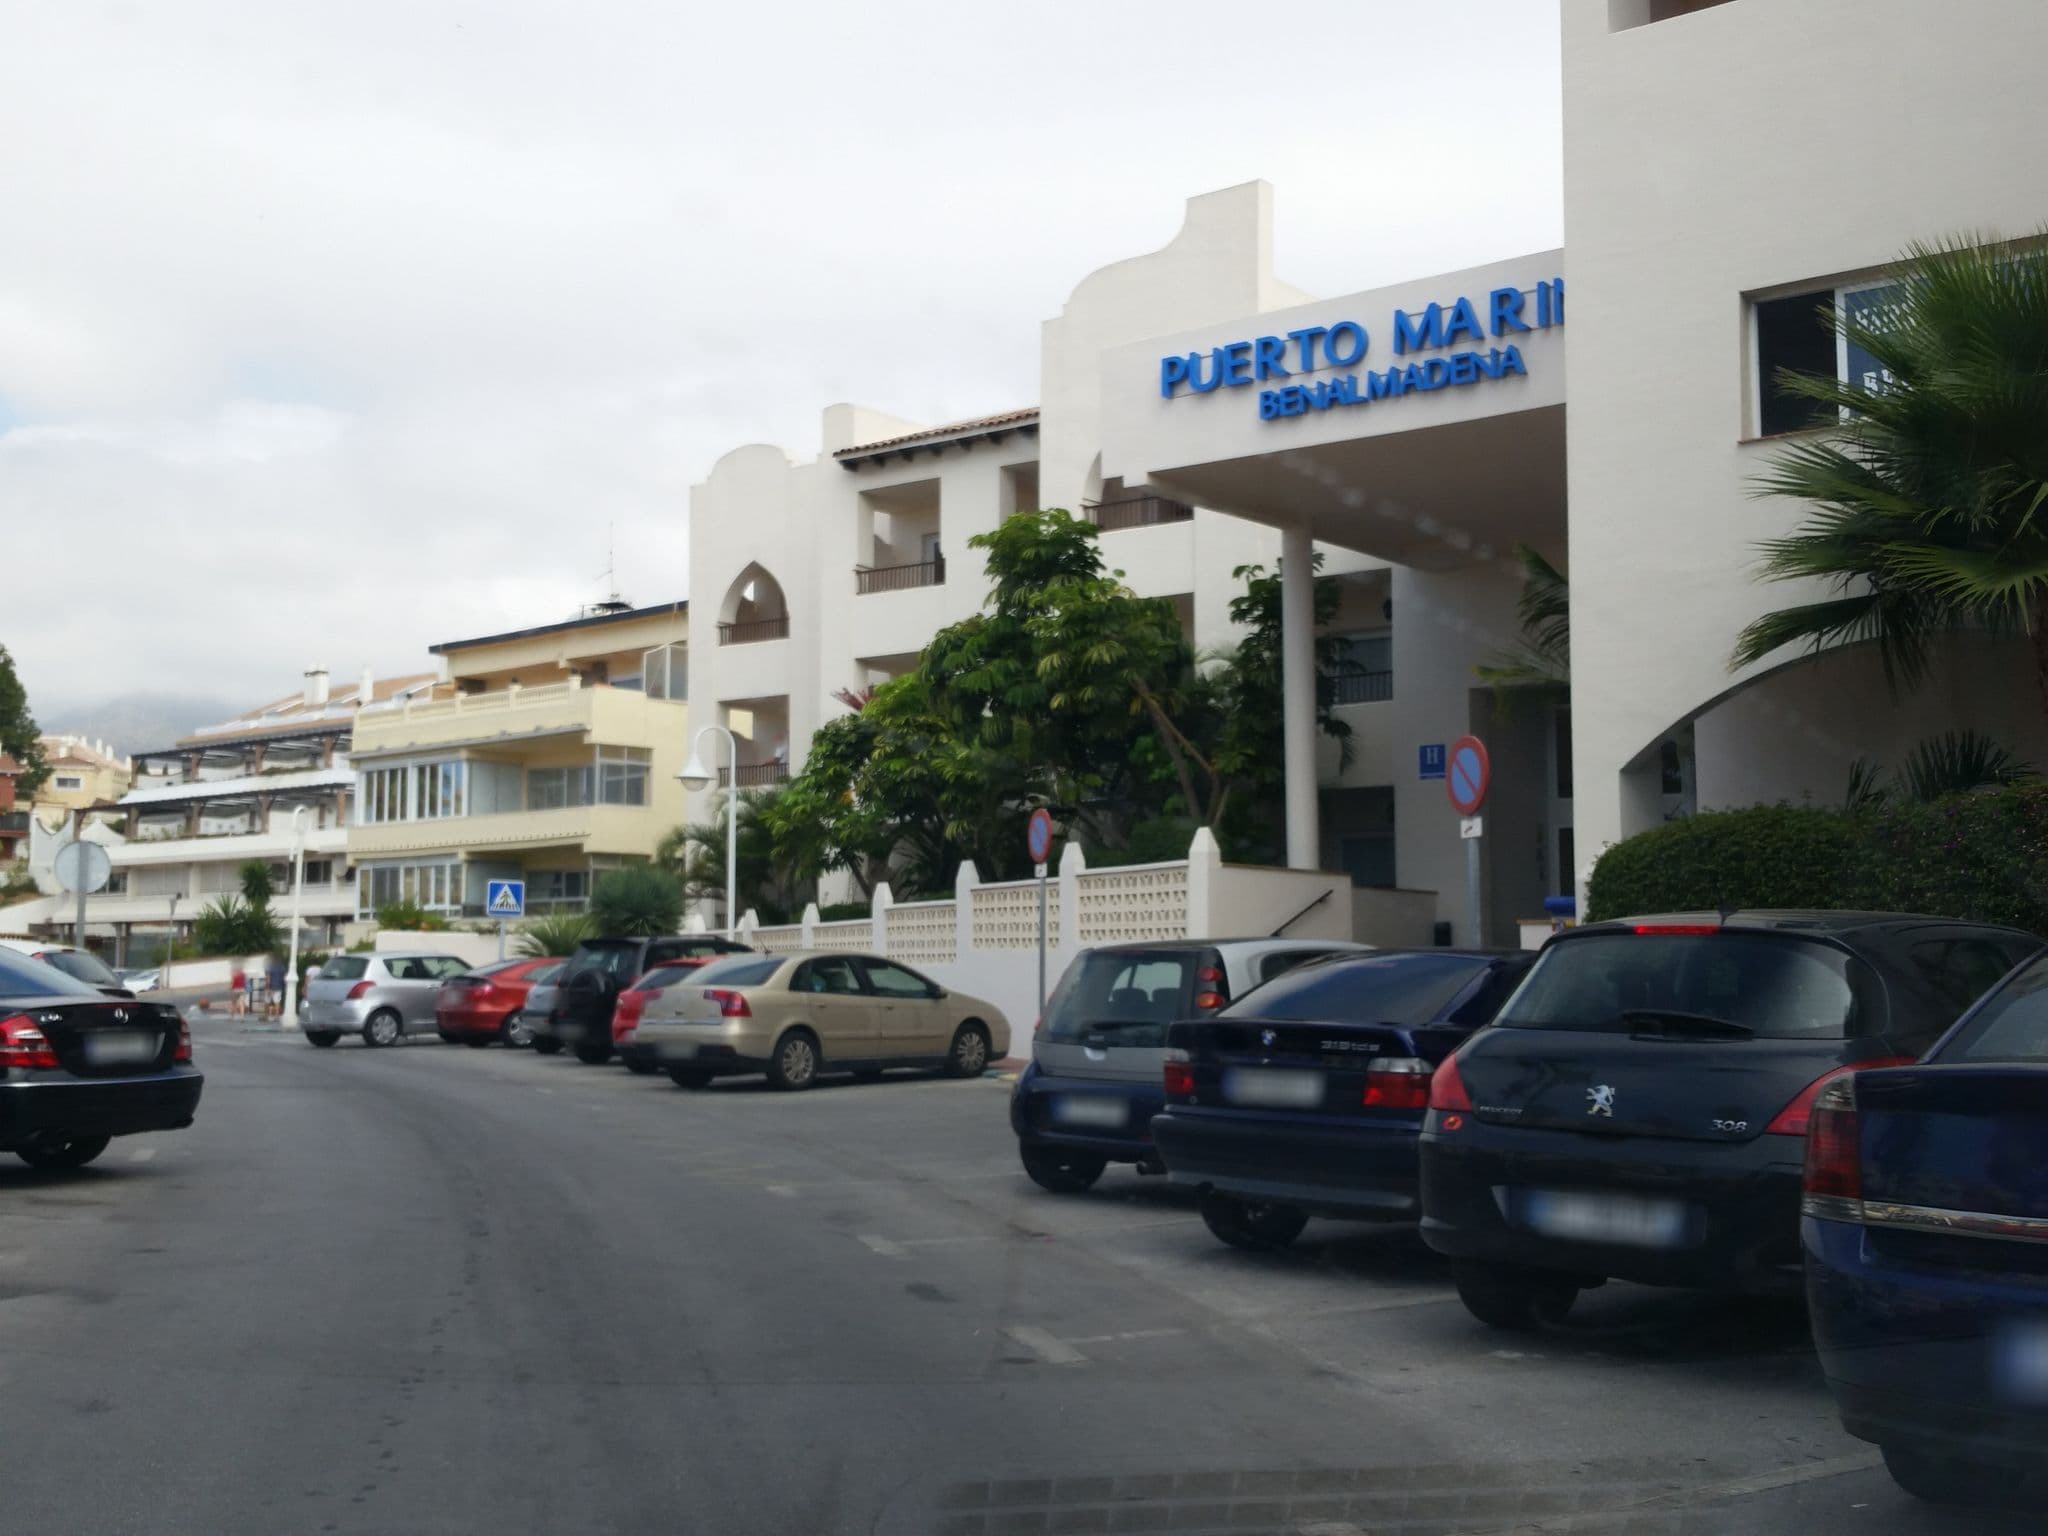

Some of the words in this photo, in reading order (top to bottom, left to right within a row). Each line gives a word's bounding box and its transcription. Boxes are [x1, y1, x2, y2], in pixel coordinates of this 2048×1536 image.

[1161, 321, 1369, 399] PUERTO
[1259, 345, 1528, 421] BENALMADENA
[1712, 1119, 1748, 1132] 308
